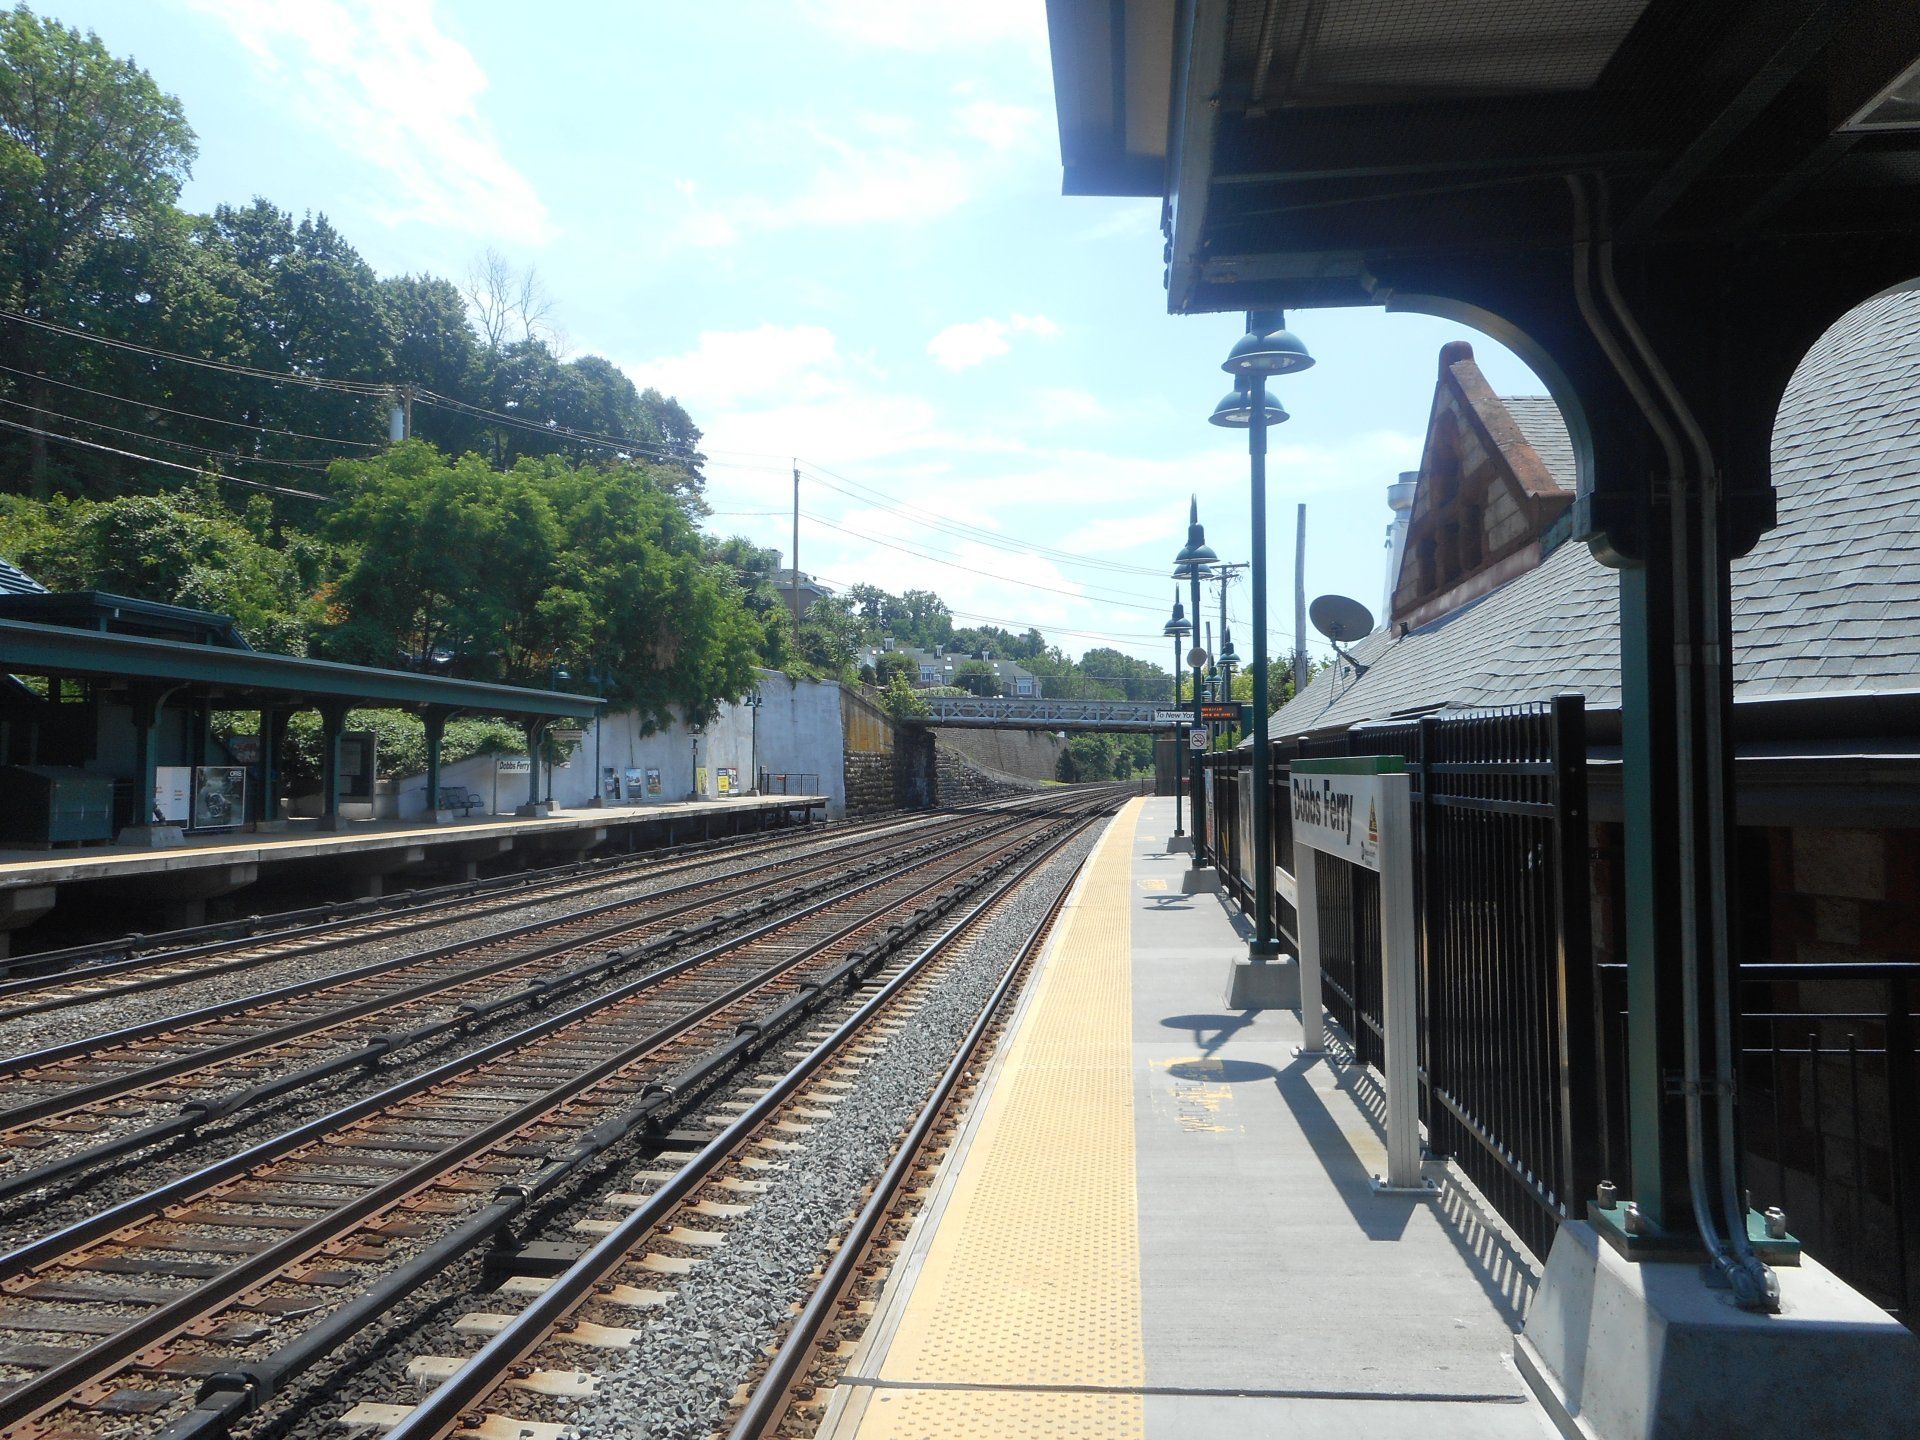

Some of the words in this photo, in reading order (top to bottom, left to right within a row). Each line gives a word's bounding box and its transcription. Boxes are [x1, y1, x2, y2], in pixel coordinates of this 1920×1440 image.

[499, 761, 516, 770] Dobbs
[517, 761, 530, 771] Ferry
[1294, 778, 1321, 826] Dobbs
[1323, 779, 1353, 845] Ferry
